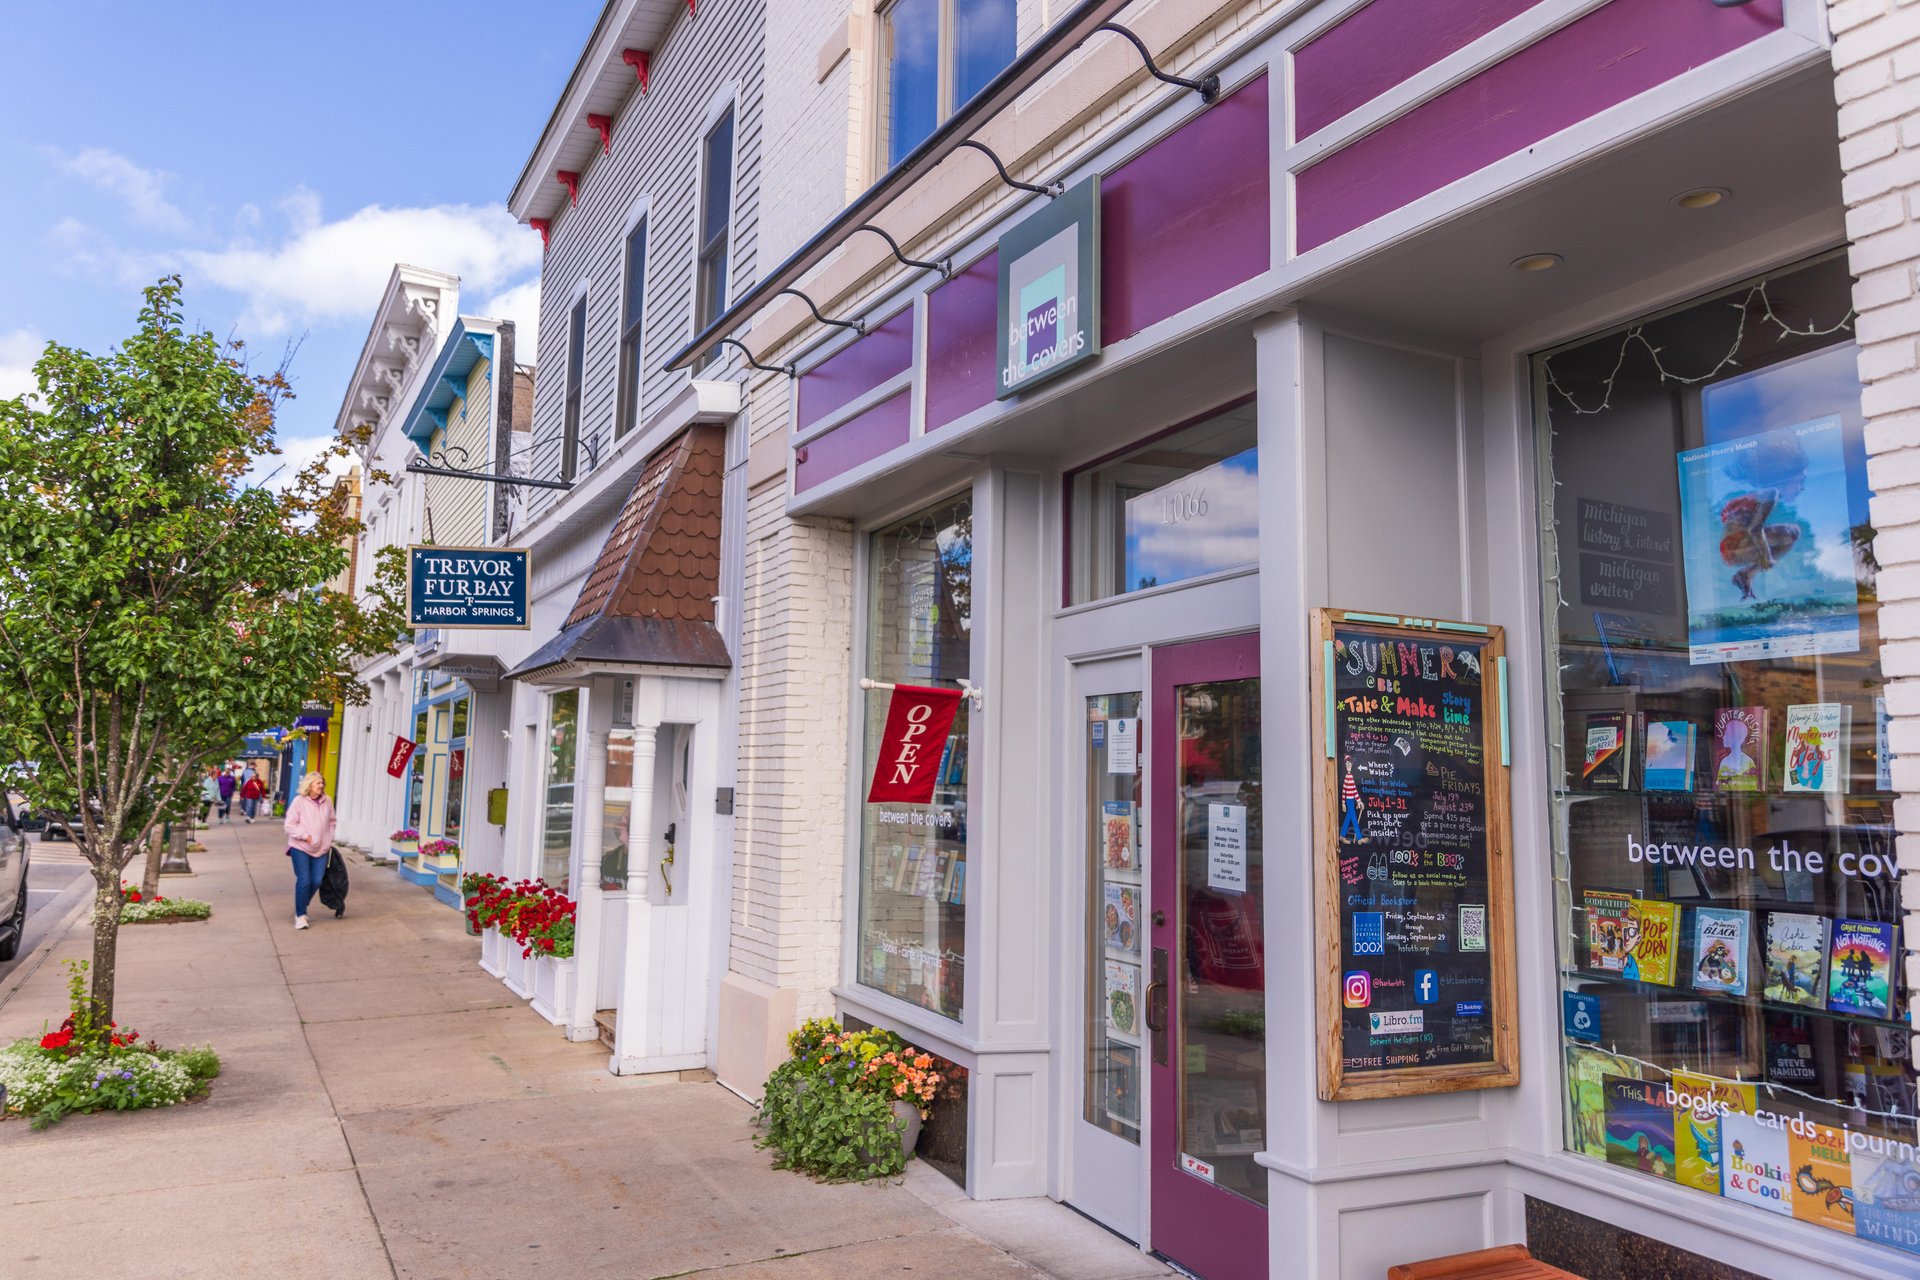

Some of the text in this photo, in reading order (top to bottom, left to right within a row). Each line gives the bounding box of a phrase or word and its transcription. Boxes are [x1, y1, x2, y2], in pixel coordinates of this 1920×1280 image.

[1010, 296, 1076, 346] between
[1002, 330, 1085, 386] the covers
[1795, 428, 1814, 437] April
[1682, 441, 1758, 463] National Poetry Month
[1160, 485, 1200, 525] 1066
[1583, 503, 1648, 535] michigan
[1583, 523, 1672, 553] history & interest
[424, 558, 514, 577] TREVOR
[1600, 559, 1660, 591] michigan
[424, 578, 514, 597] FURBAY
[1590, 582, 1634, 601] writers
[424, 606, 514, 617] HARBOR SPRINGS
[1345, 639, 1457, 681] SUMMER
[1344, 695, 1436, 718] Take & Make
[1441, 690, 1471, 714] story
[1348, 716, 1363, 726] every
[1443, 706, 1470, 725] time
[1358, 725, 1383, 733] purchase
[1384, 727, 1414, 739] necessary
[1715, 709, 1759, 745] JUPITER RISING
[1787, 724, 1839, 743] Mysterious
[889, 704, 932, 784] OPEN
[390, 741, 410, 770] OPEN
[1368, 761, 1395, 770] Where's
[1369, 769, 1394, 777] Waldo?
[1441, 766, 1456, 780] PIE
[1361, 777, 1375, 785] Look
[1442, 780, 1481, 795] FRIDAYS
[1368, 797, 1385, 812] July
[1432, 791, 1447, 805] July
[1433, 802, 1457, 814] August
[880, 807, 952, 828] between the covers
[1367, 811, 1411, 823] Pick up your
[1424, 811, 1472, 824] Spend $25 and
[1367, 820, 1402, 831] passport
[1421, 821, 1457, 831] get piece
[1370, 828, 1399, 838] inside!
[1421, 830, 1458, 840] homemade
[1390, 849, 1465, 870] LOOK BOOK
[1627, 833, 1899, 879] between the cov
[1392, 870, 1408, 881] follow
[1348, 893, 1418, 906] Official Bookstore
[1584, 897, 1629, 909] GODFATHER
[1406, 911, 1435, 922] September
[1597, 908, 1621, 917] DEATH
[1405, 923, 1425, 933] through
[1642, 918, 1668, 939] POP
[1703, 926, 1737, 936] BLACK
[1840, 924, 1881, 934] GAYLE FORMAN
[1409, 931, 1437, 942] September
[1835, 933, 1886, 953] NOT NOTHING
[1638, 938, 1668, 960] CORN
[1384, 1014, 1423, 1026] Libro.fm
[1370, 1034, 1420, 1047] Between the Covers
[1437, 1045, 1449, 1053] Free
[1363, 1054, 1420, 1066] FREE SHIPPING
[1777, 1058, 1806, 1067] STEVE
[1770, 1067, 1815, 1078] HAMILTON
[1665, 1082, 1730, 1117] books
[1753, 1112, 1816, 1140] cards
[1730, 1174, 1744, 1190] &
